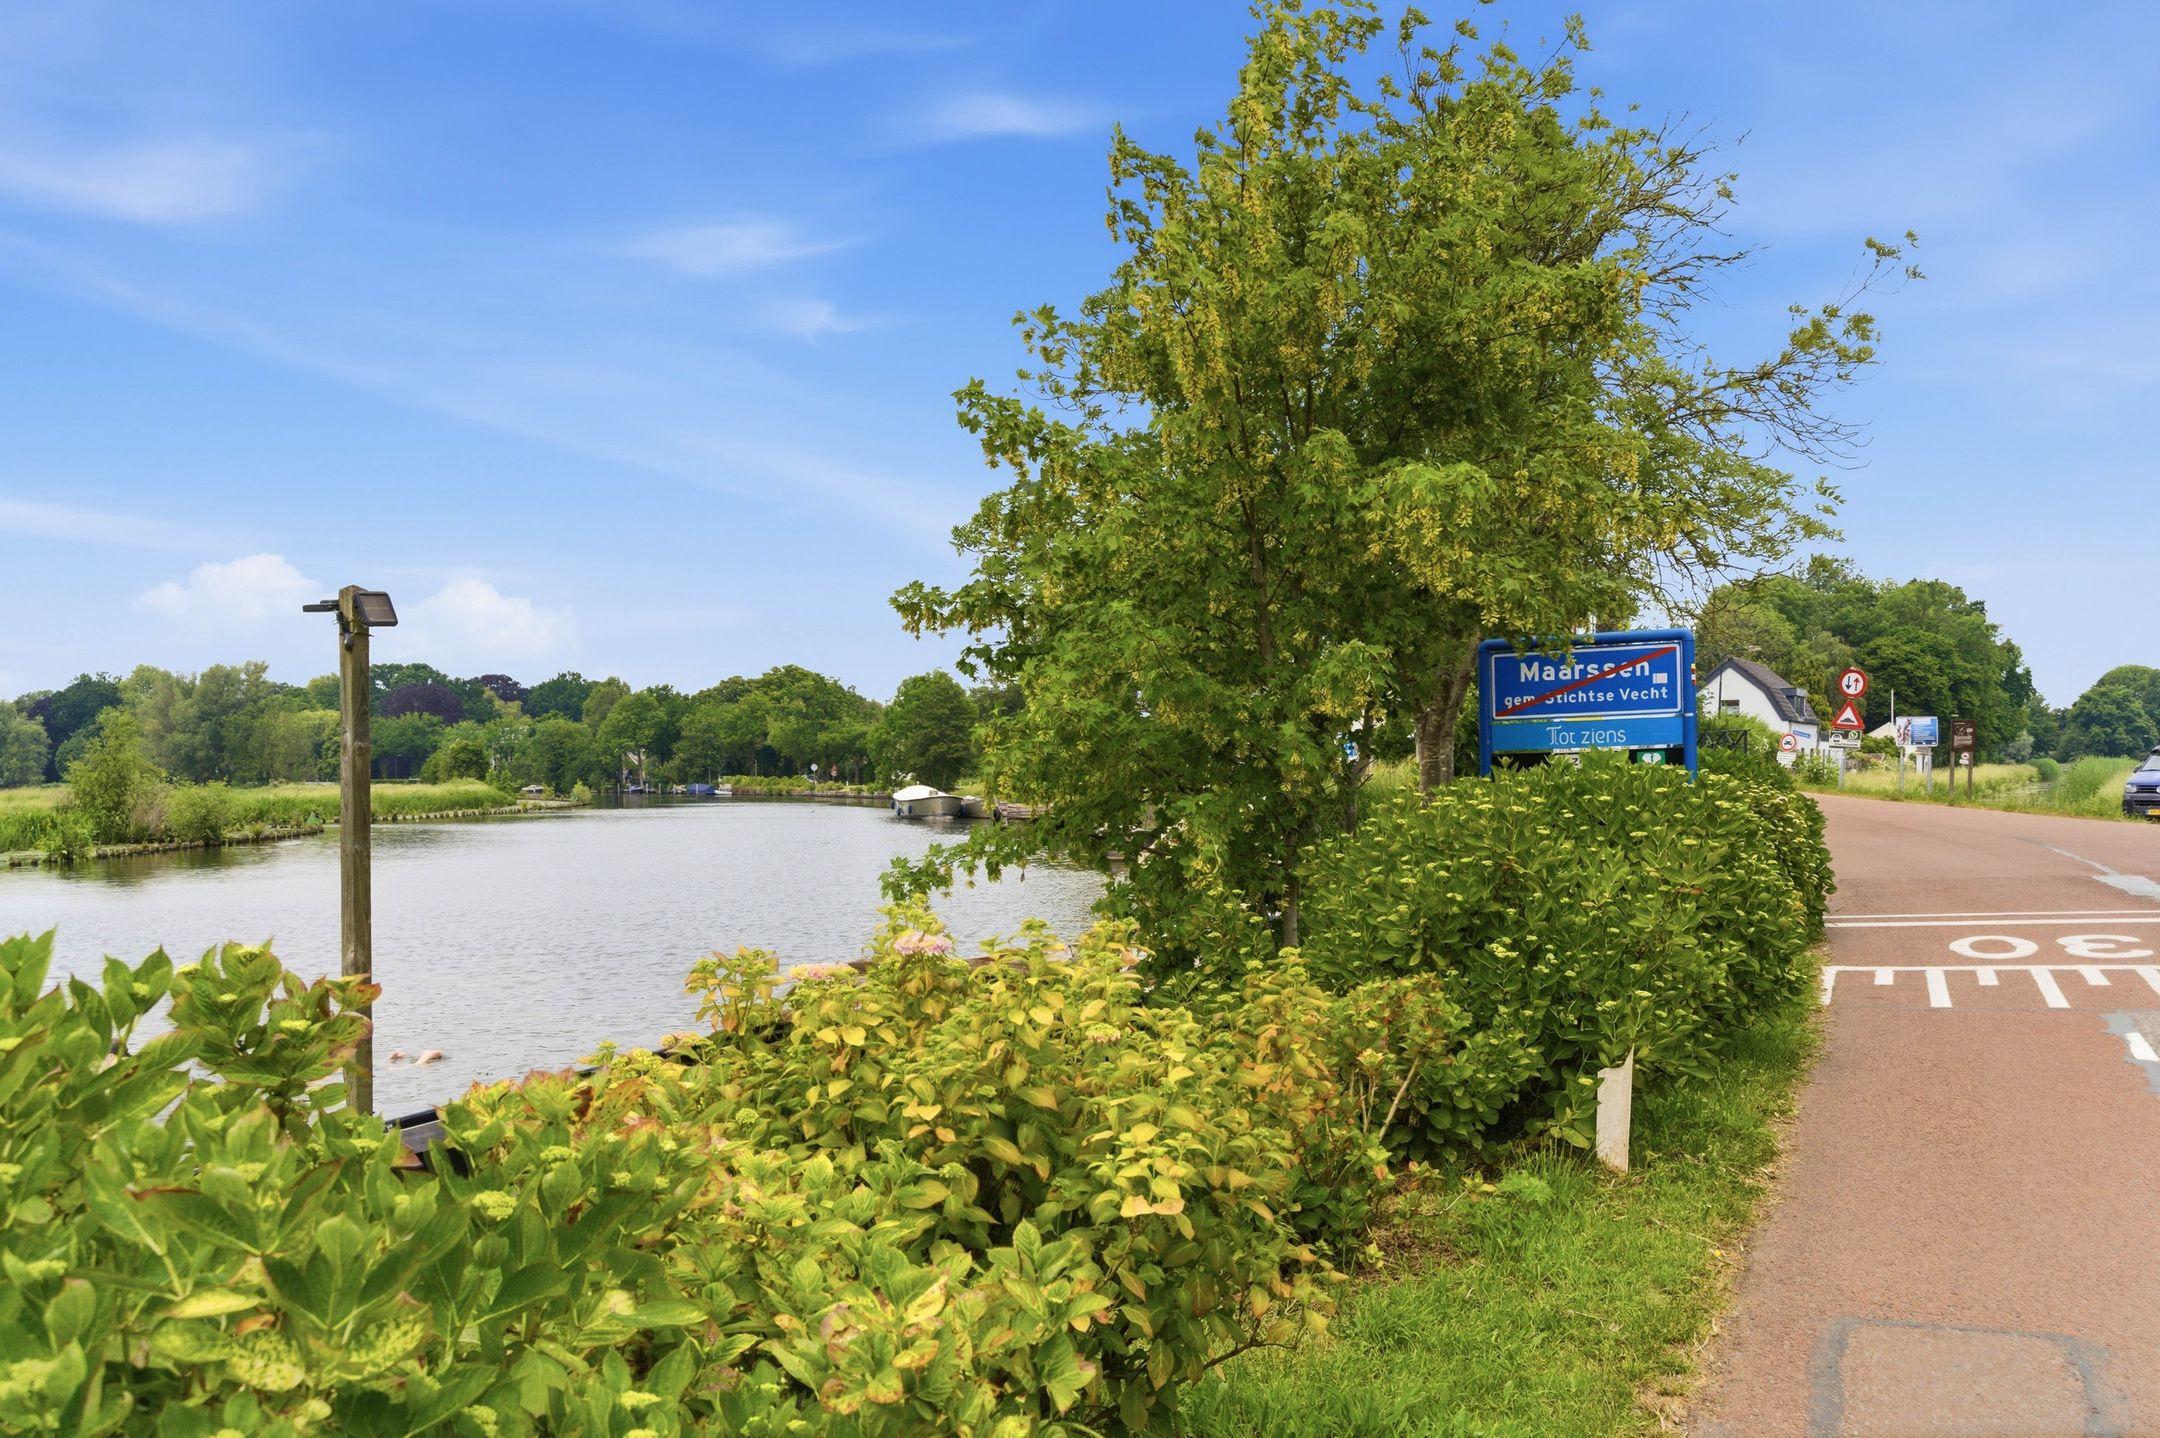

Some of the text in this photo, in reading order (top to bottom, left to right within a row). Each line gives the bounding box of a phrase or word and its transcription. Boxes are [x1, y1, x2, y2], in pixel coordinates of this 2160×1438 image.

[1519, 660, 1650, 683] Maarssen
[1545, 691, 1615, 705] Stichtse
[1619, 687, 1669, 701] Vecht
[1546, 725, 1627, 745] Tot ziens
[1948, 934, 2155, 959] 30
